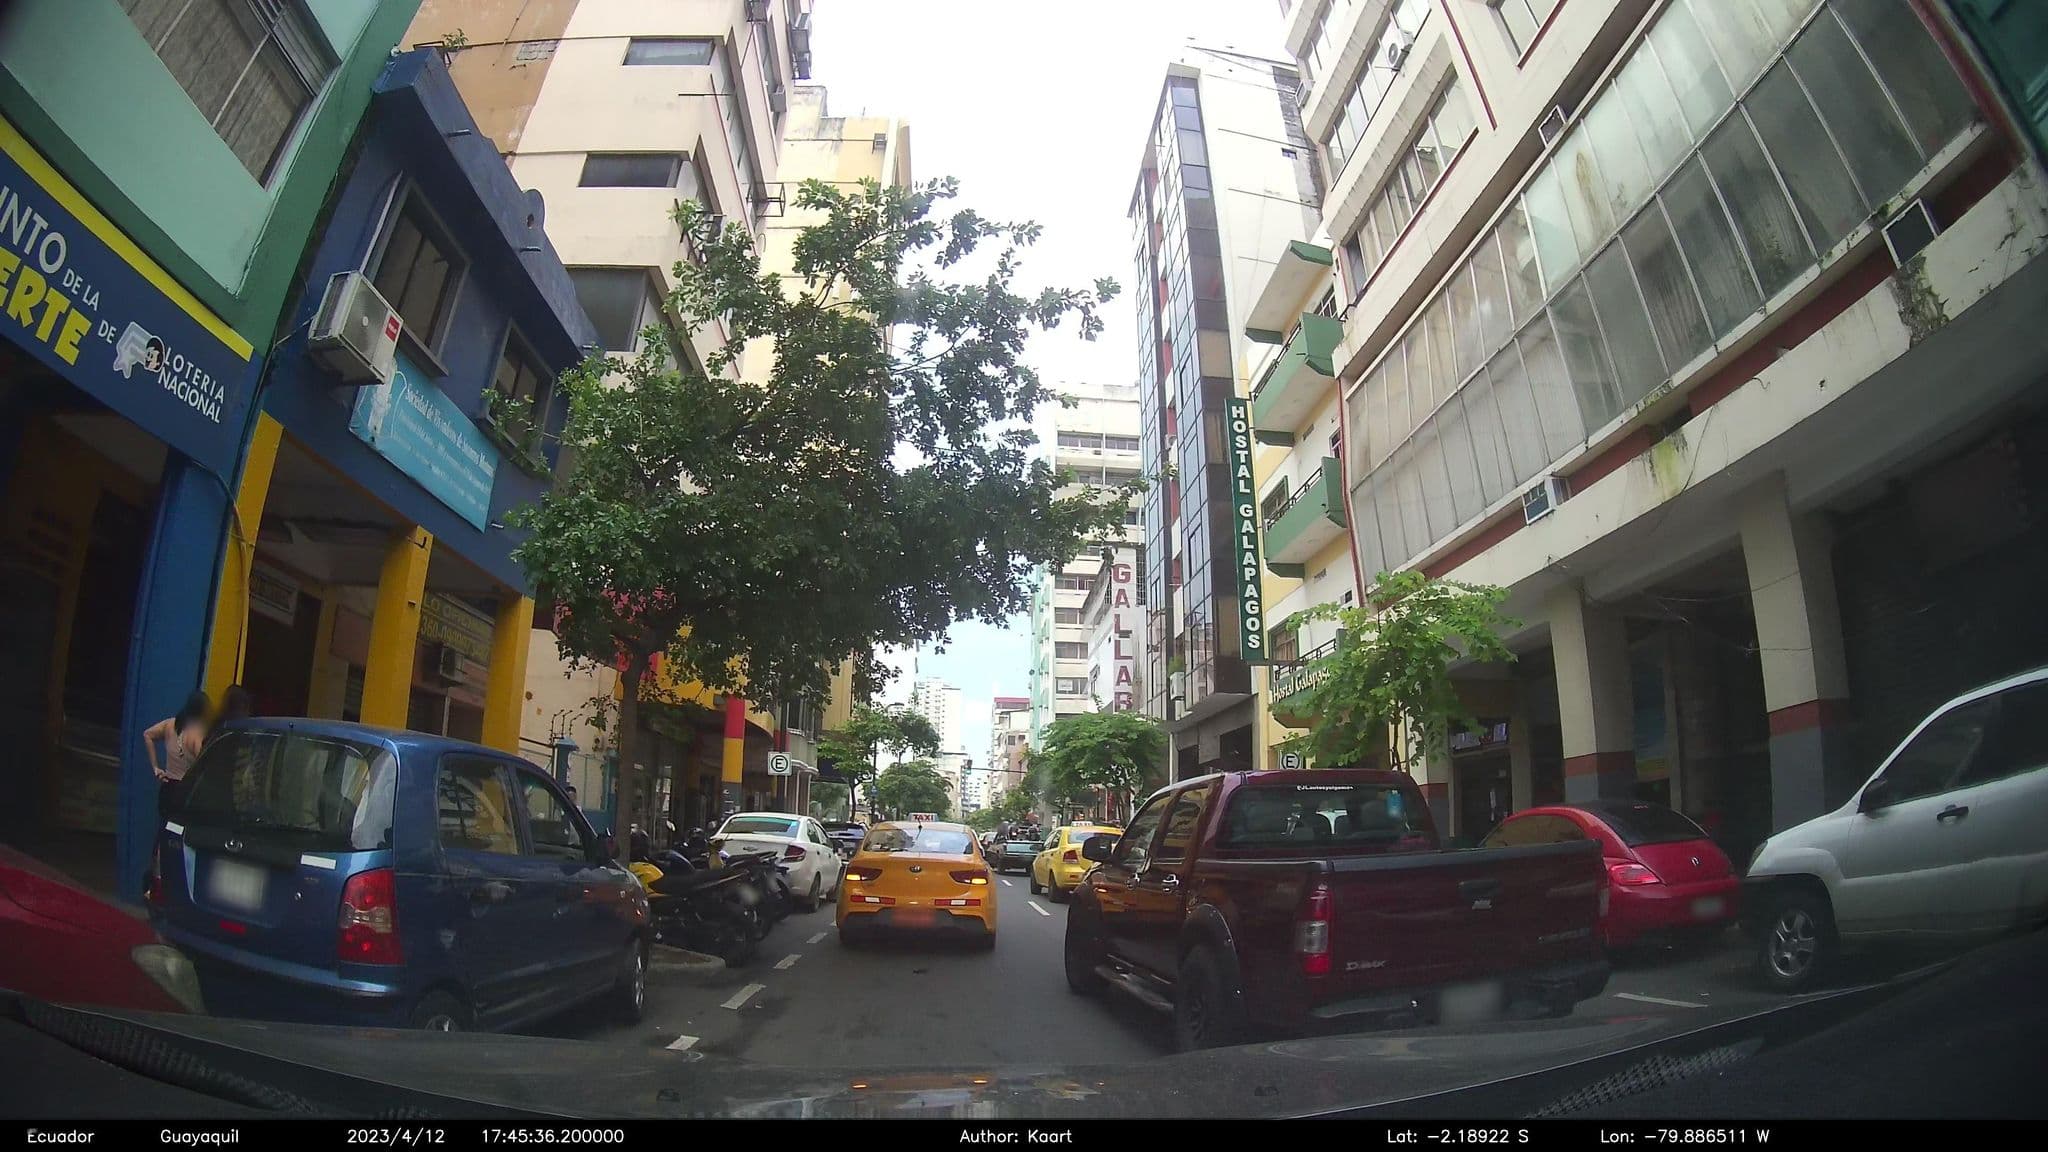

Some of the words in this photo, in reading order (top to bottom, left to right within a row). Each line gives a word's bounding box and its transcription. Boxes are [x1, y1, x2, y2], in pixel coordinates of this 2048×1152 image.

[0, 185, 67, 274] NTO
[63, 268, 84, 296] DE
[82, 285, 101, 312] LA
[98, 319, 117, 345] DE
[157, 365, 222, 424] NACIONAL
[163, 346, 225, 405] LOTERIA
[1231, 404, 1251, 494] HOSTAL
[1238, 503, 1261, 649] GALAPAGOS
[1273, 675, 1295, 703] Hostal
